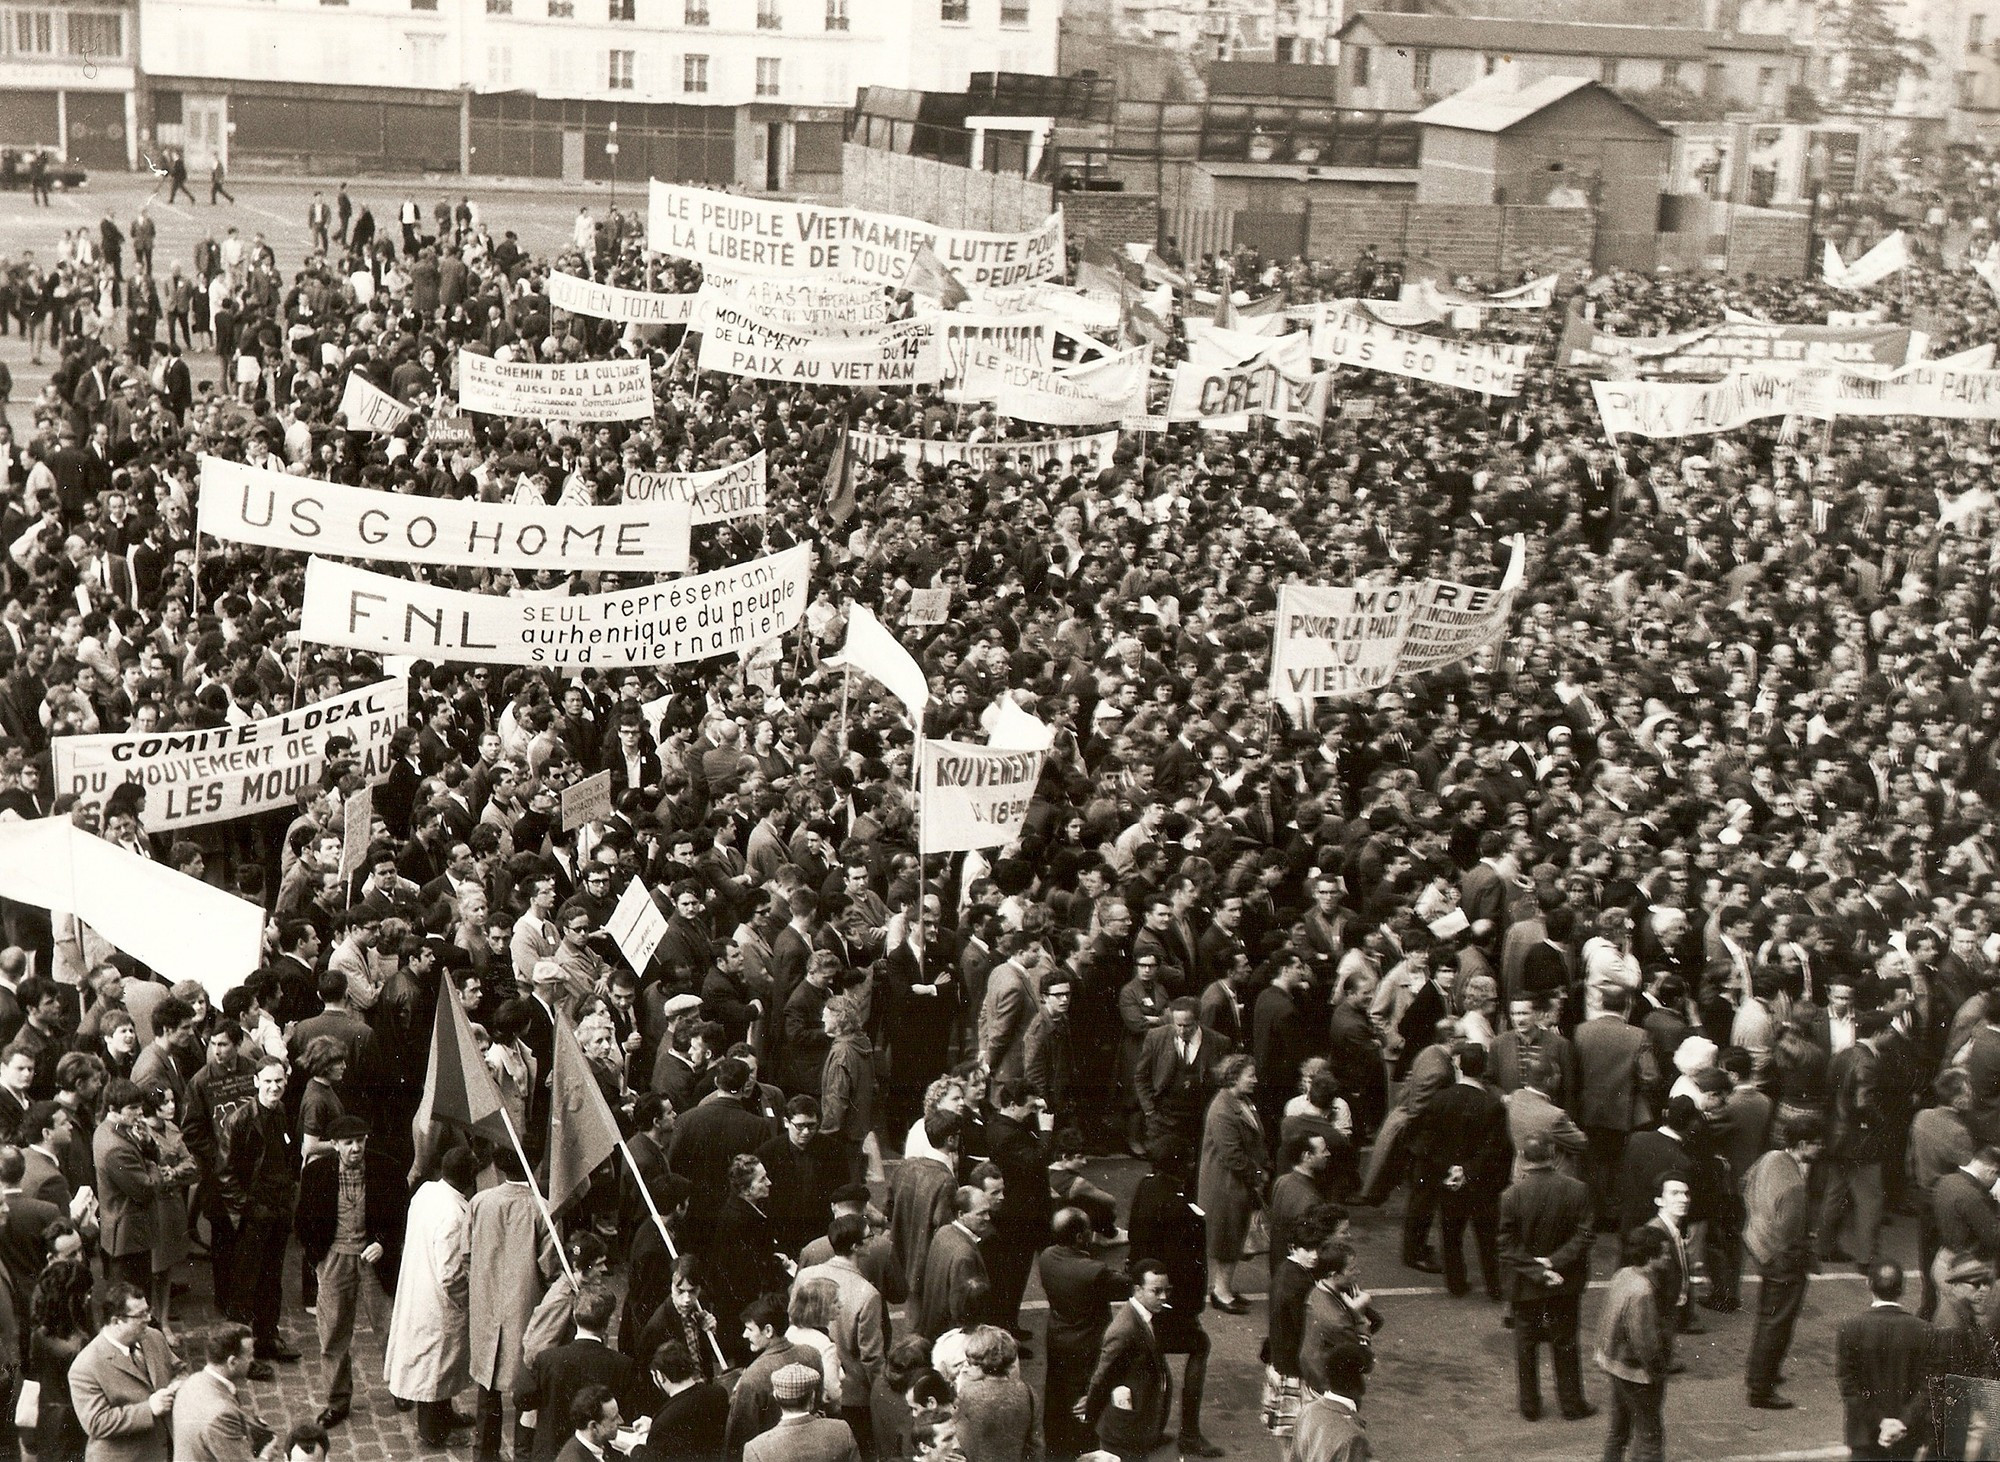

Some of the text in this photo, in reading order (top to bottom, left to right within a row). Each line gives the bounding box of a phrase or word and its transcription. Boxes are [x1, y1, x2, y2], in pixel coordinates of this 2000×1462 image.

[667, 193, 689, 220] LE
[702, 203, 783, 237] PEUPLE
[949, 238, 1018, 262] LUTTE
[673, 224, 696, 250] LA
[810, 245, 840, 267] DE
[852, 244, 906, 280] TOUS
[976, 253, 1055, 287] PEUPLES
[553, 278, 612, 313] SOUTIEN
[622, 296, 669, 318] TOTAL
[715, 326, 733, 342] DE
[738, 332, 755, 346] LA
[716, 306, 812, 347] MOUVEMENT
[471, 358, 641, 381] LE CHEMIN DE LA CULTURE
[732, 352, 784, 375] PAIX
[793, 361, 821, 379] AU
[883, 347, 899, 360] DU
[975, 351, 998, 370] LE
[1403, 350, 1435, 373] GO
[1455, 361, 1525, 391] HOME
[515, 383, 552, 395] AUSSI
[560, 387, 583, 397] PAR
[592, 382, 613, 397] LA
[618, 376, 646, 395] PAIX
[241, 485, 650, 557] US GO HOME
[521, 578, 796, 646] authentique du peuple
[522, 605, 591, 623] SEUL
[281, 695, 386, 737] LOCAL
[73, 711, 405, 796] DU MOUVEMENT DE A PAI
[165, 781, 224, 820] LES
